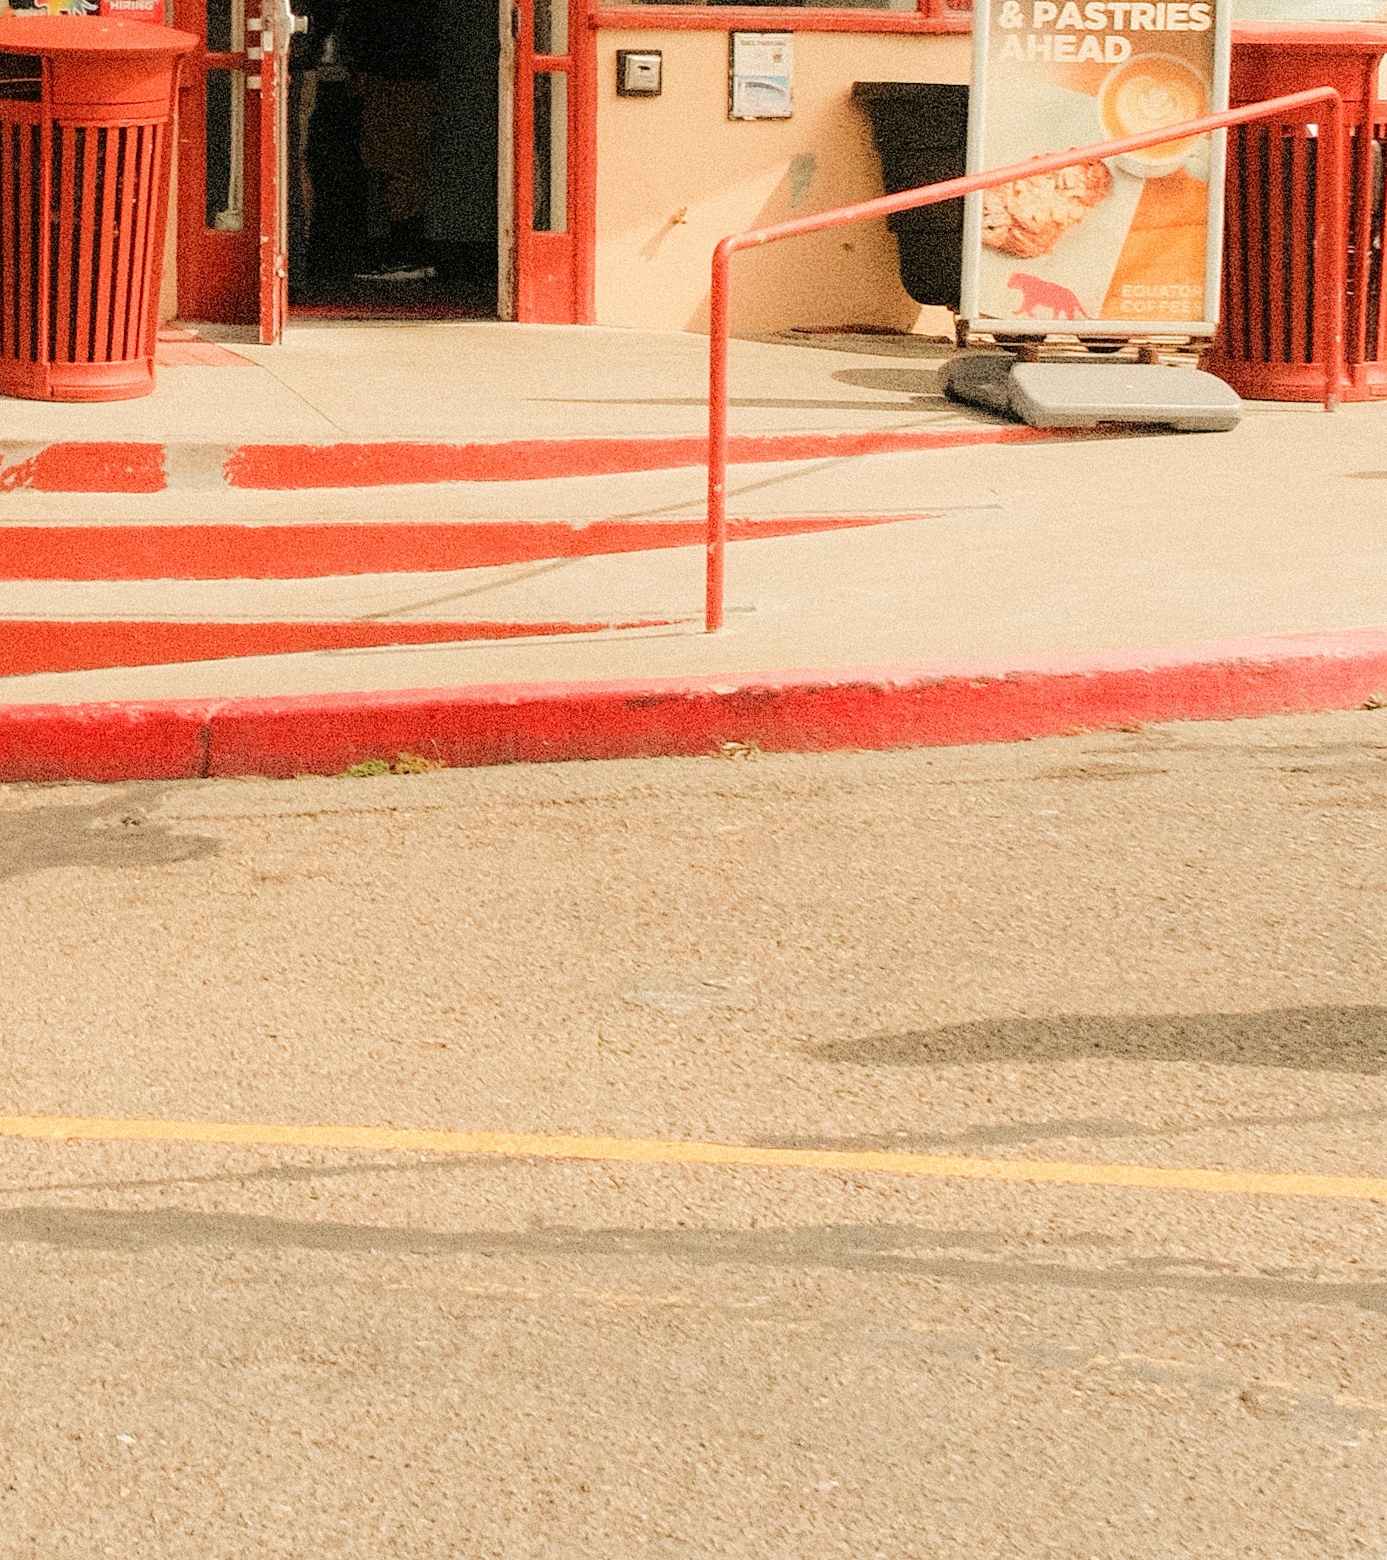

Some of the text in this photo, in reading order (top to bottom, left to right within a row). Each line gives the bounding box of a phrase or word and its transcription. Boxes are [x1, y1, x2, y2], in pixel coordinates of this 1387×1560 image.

[109, 0, 154, 11] HIRING
[999, 0, 1212, 31] & PASTRIES
[1001, 34, 1132, 63] AHEAD
